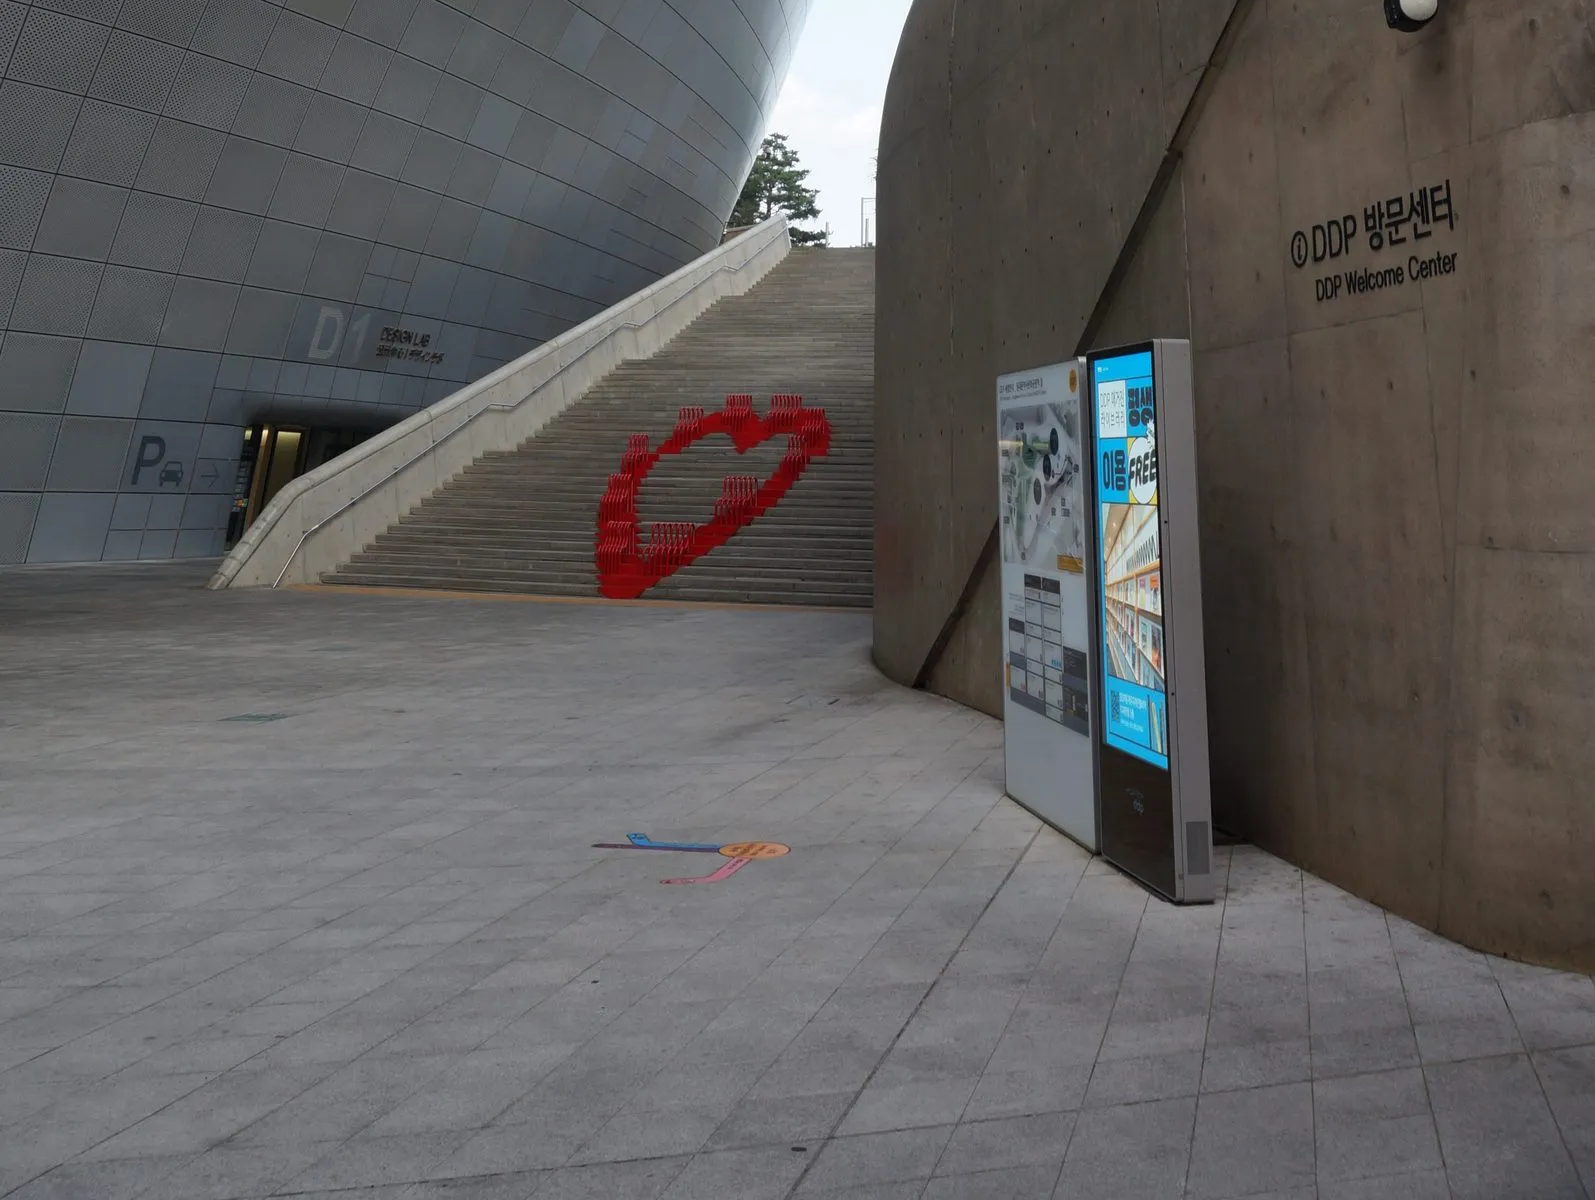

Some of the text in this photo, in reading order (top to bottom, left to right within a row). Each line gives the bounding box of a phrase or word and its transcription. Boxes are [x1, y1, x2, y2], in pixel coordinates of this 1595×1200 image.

[1312, 179, 1455, 263] DDP 방문센터
[1315, 251, 1458, 302] DDP Welcome Center
[308, 305, 372, 364] D1
[131, 434, 166, 487] P
[1103, 450, 1126, 491] 이용
[1129, 449, 1156, 488] FREE
